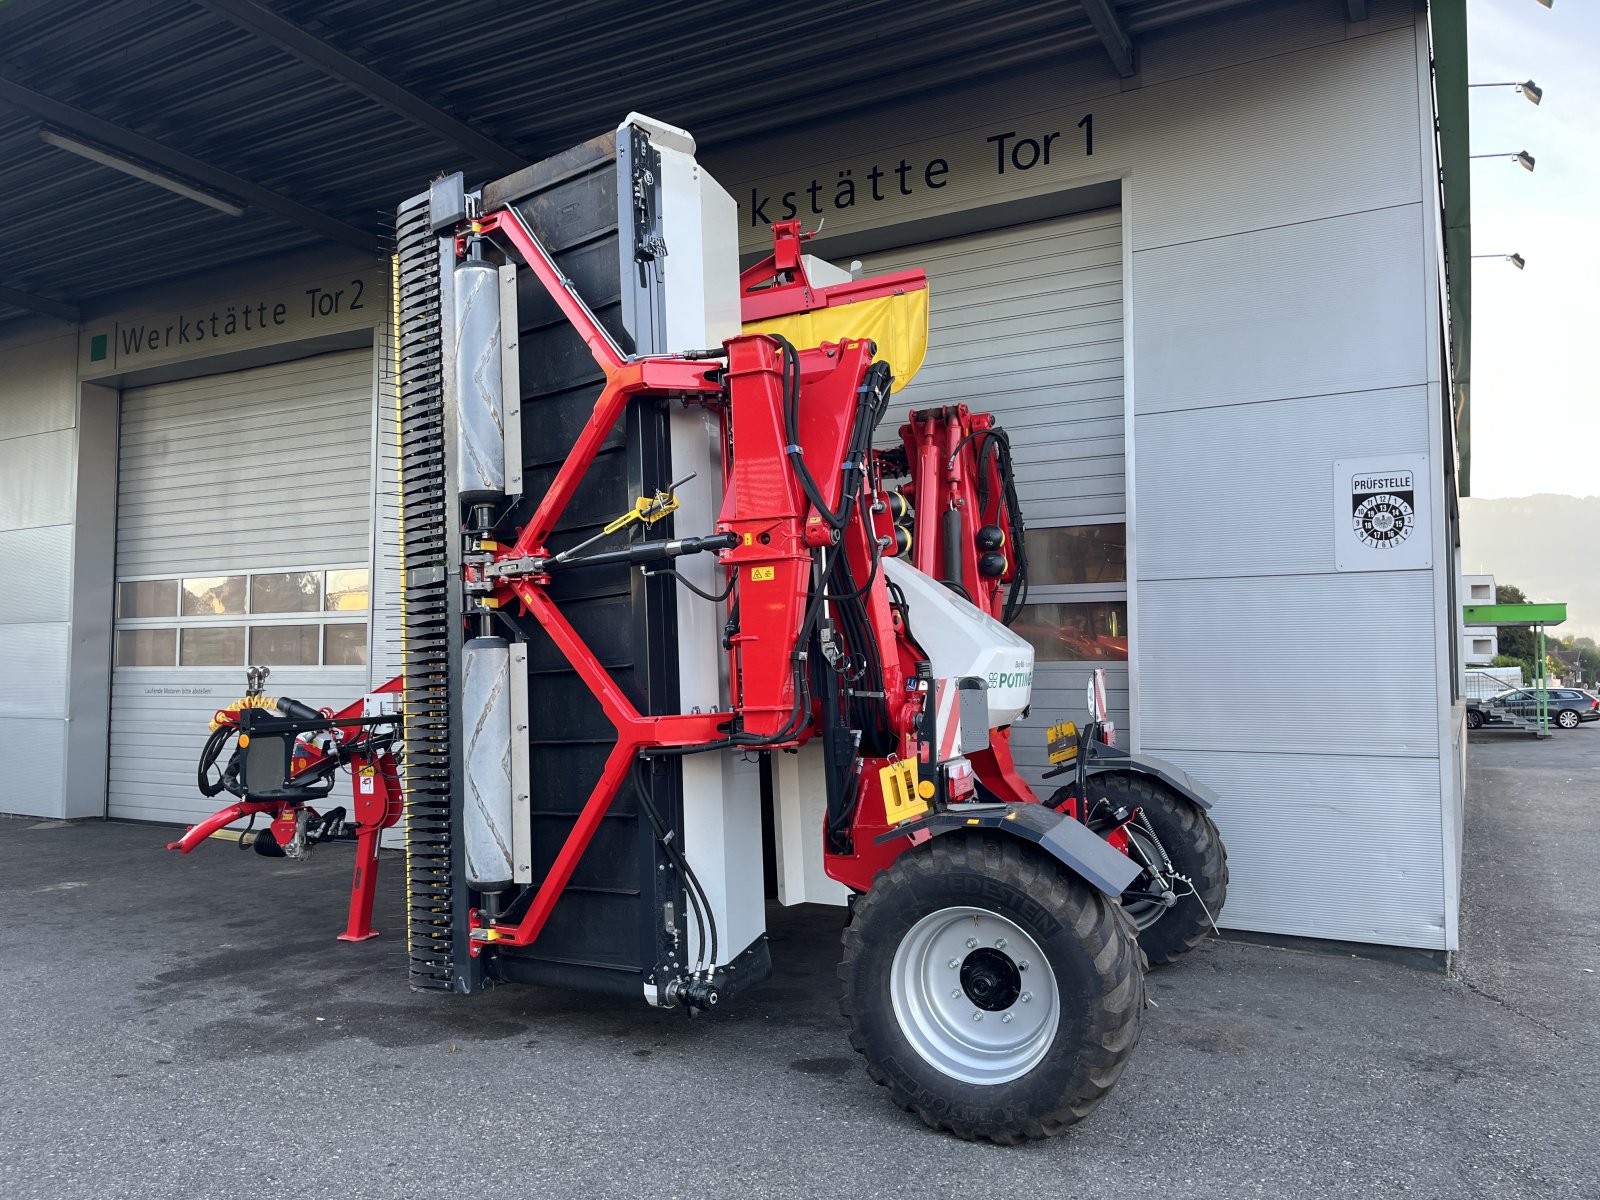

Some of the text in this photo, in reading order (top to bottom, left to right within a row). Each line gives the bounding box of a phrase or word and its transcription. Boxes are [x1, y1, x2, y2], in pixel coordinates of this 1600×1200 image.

[736, 113, 1094, 227] kstätte Tor 1
[122, 279, 364, 355] Werkstätte Tor 2
[1354, 477, 1411, 490] PRÜFSTELLE
